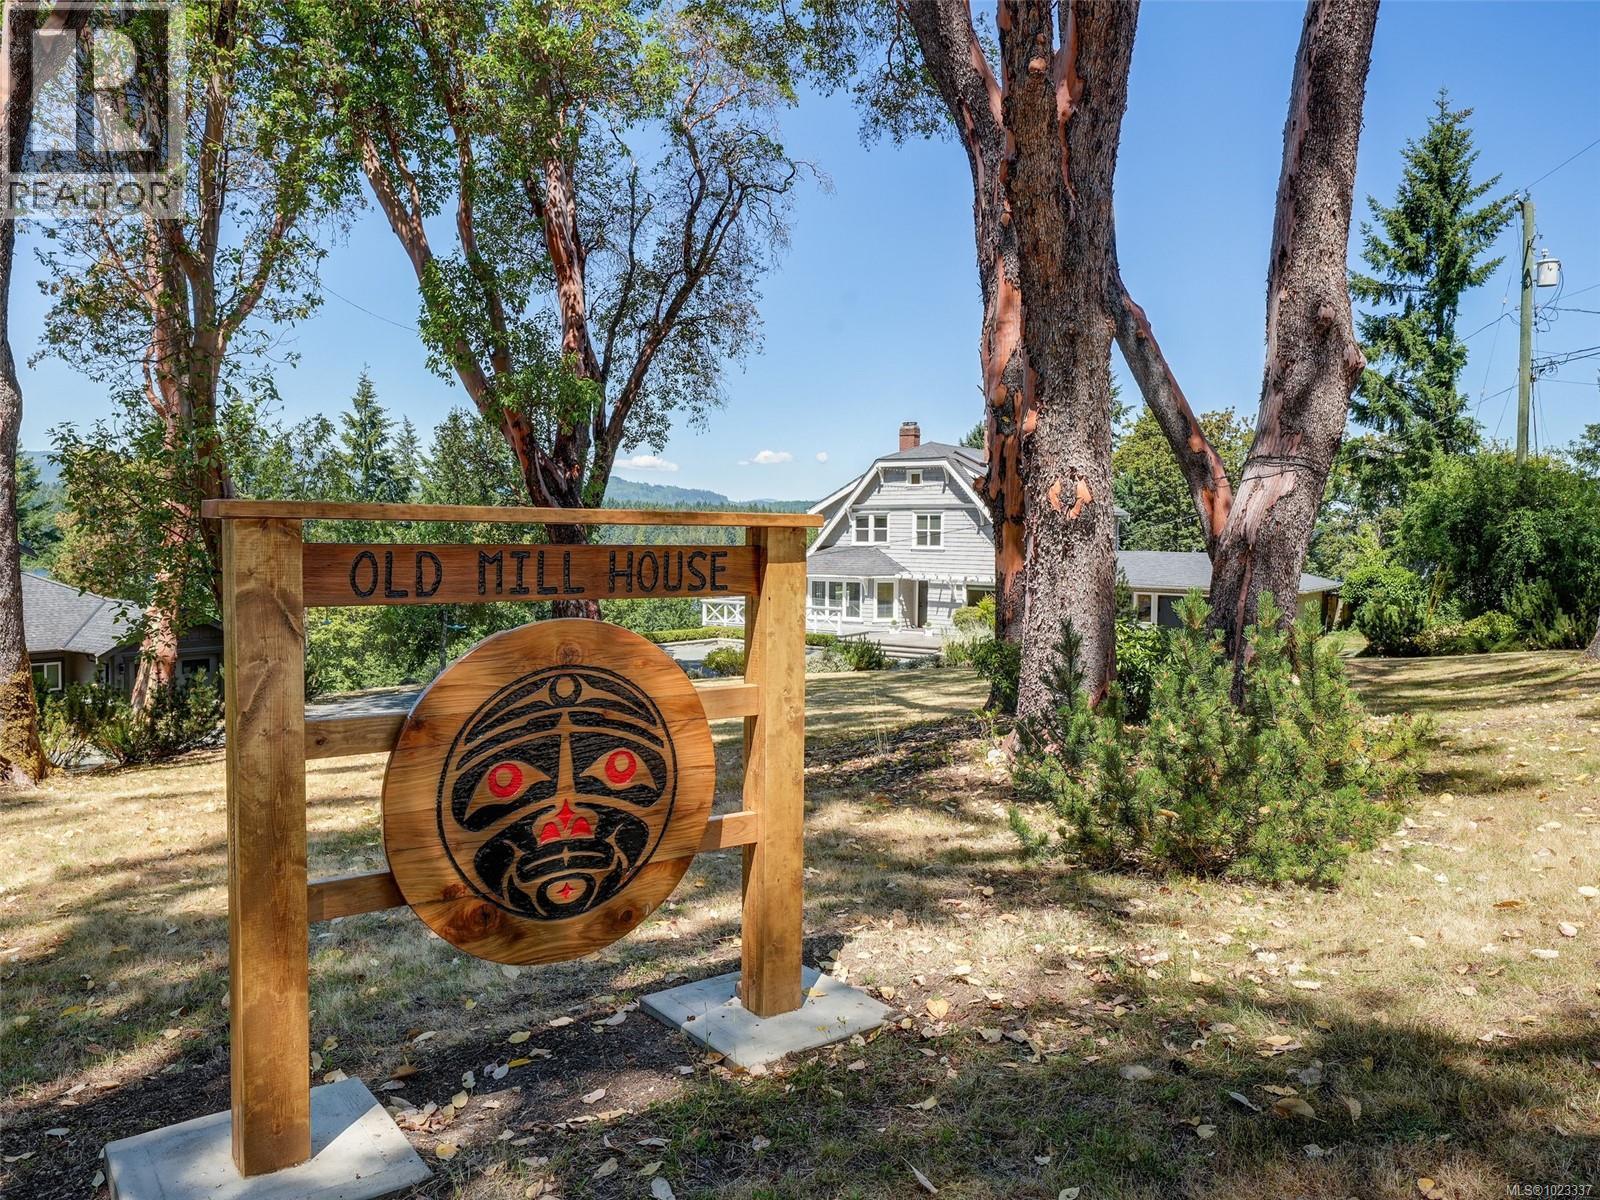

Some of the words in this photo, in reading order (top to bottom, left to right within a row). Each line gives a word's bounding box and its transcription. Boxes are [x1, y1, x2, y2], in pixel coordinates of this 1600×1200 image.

[349, 550, 443, 599] OLD
[477, 550, 586, 595] MILL
[607, 550, 729, 593] HOUSE
